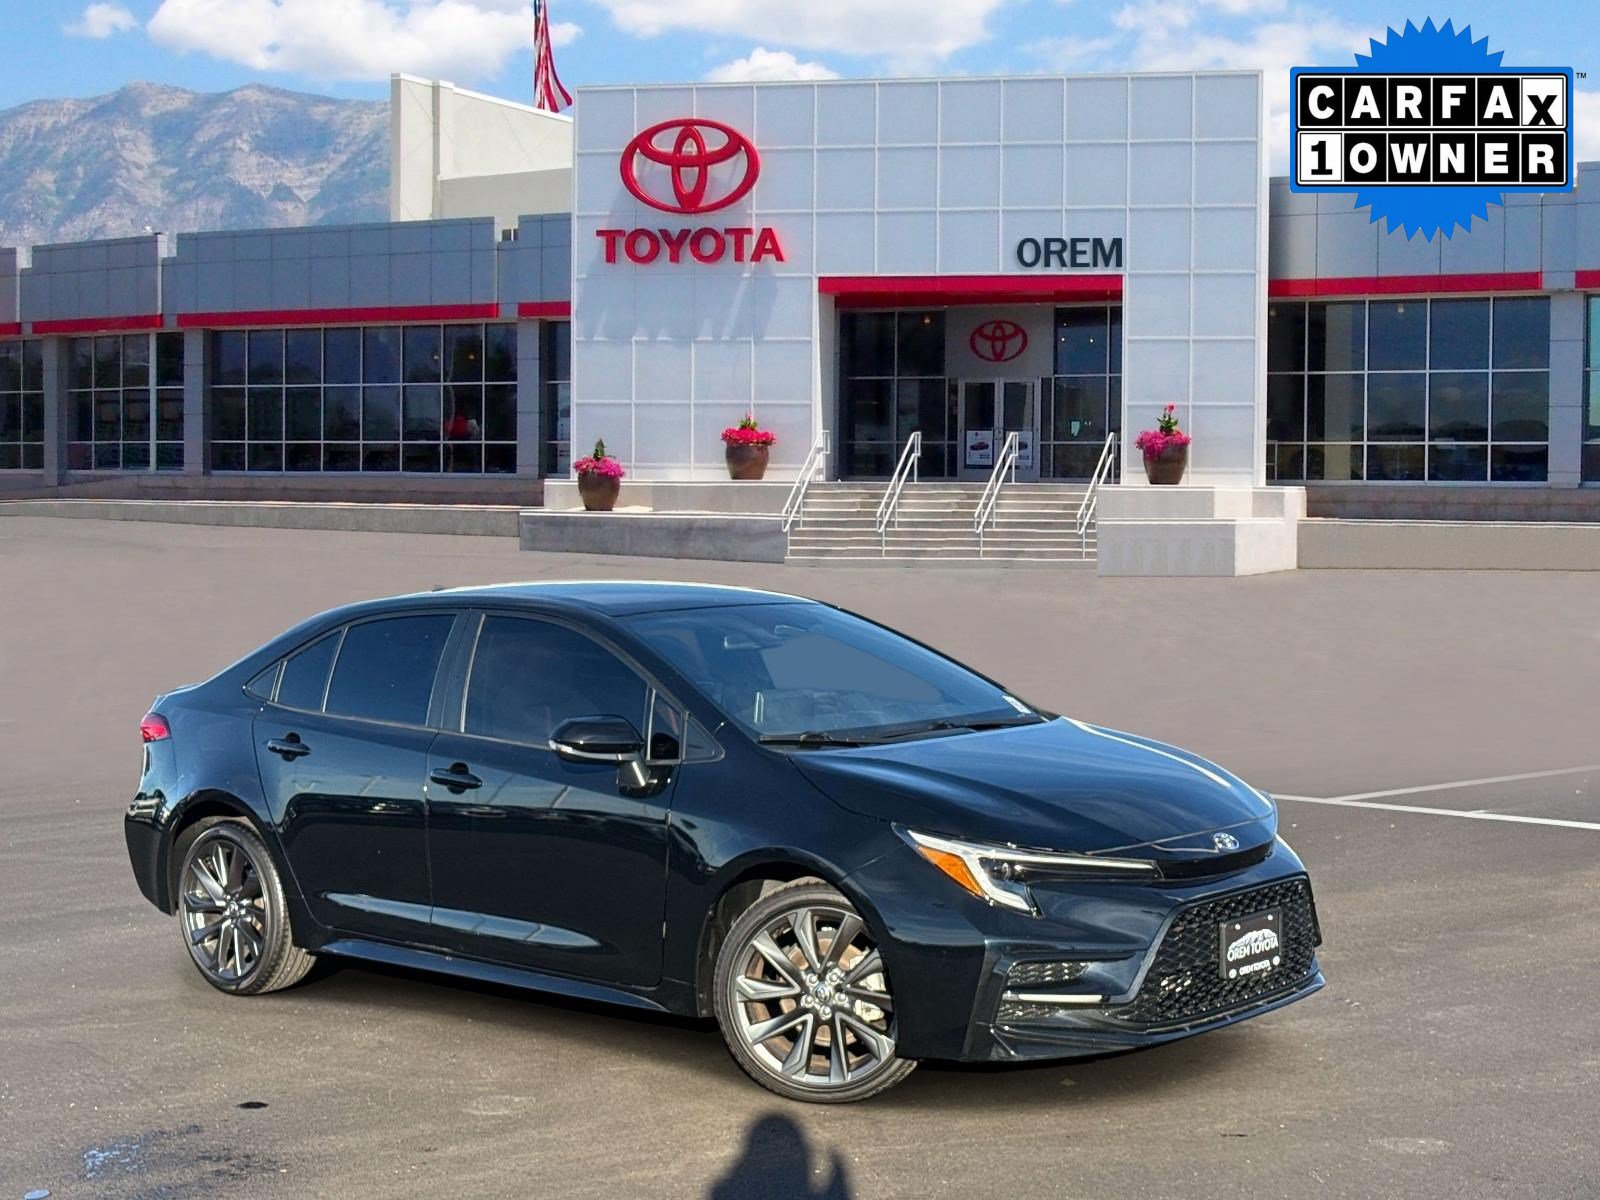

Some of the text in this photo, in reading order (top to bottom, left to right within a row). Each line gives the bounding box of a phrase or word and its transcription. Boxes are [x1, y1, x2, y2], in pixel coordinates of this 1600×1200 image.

[596, 227, 785, 264] TOYOTA
[1016, 237, 1123, 268] OREM
[1227, 935, 1279, 962] OREM TOYOTA
